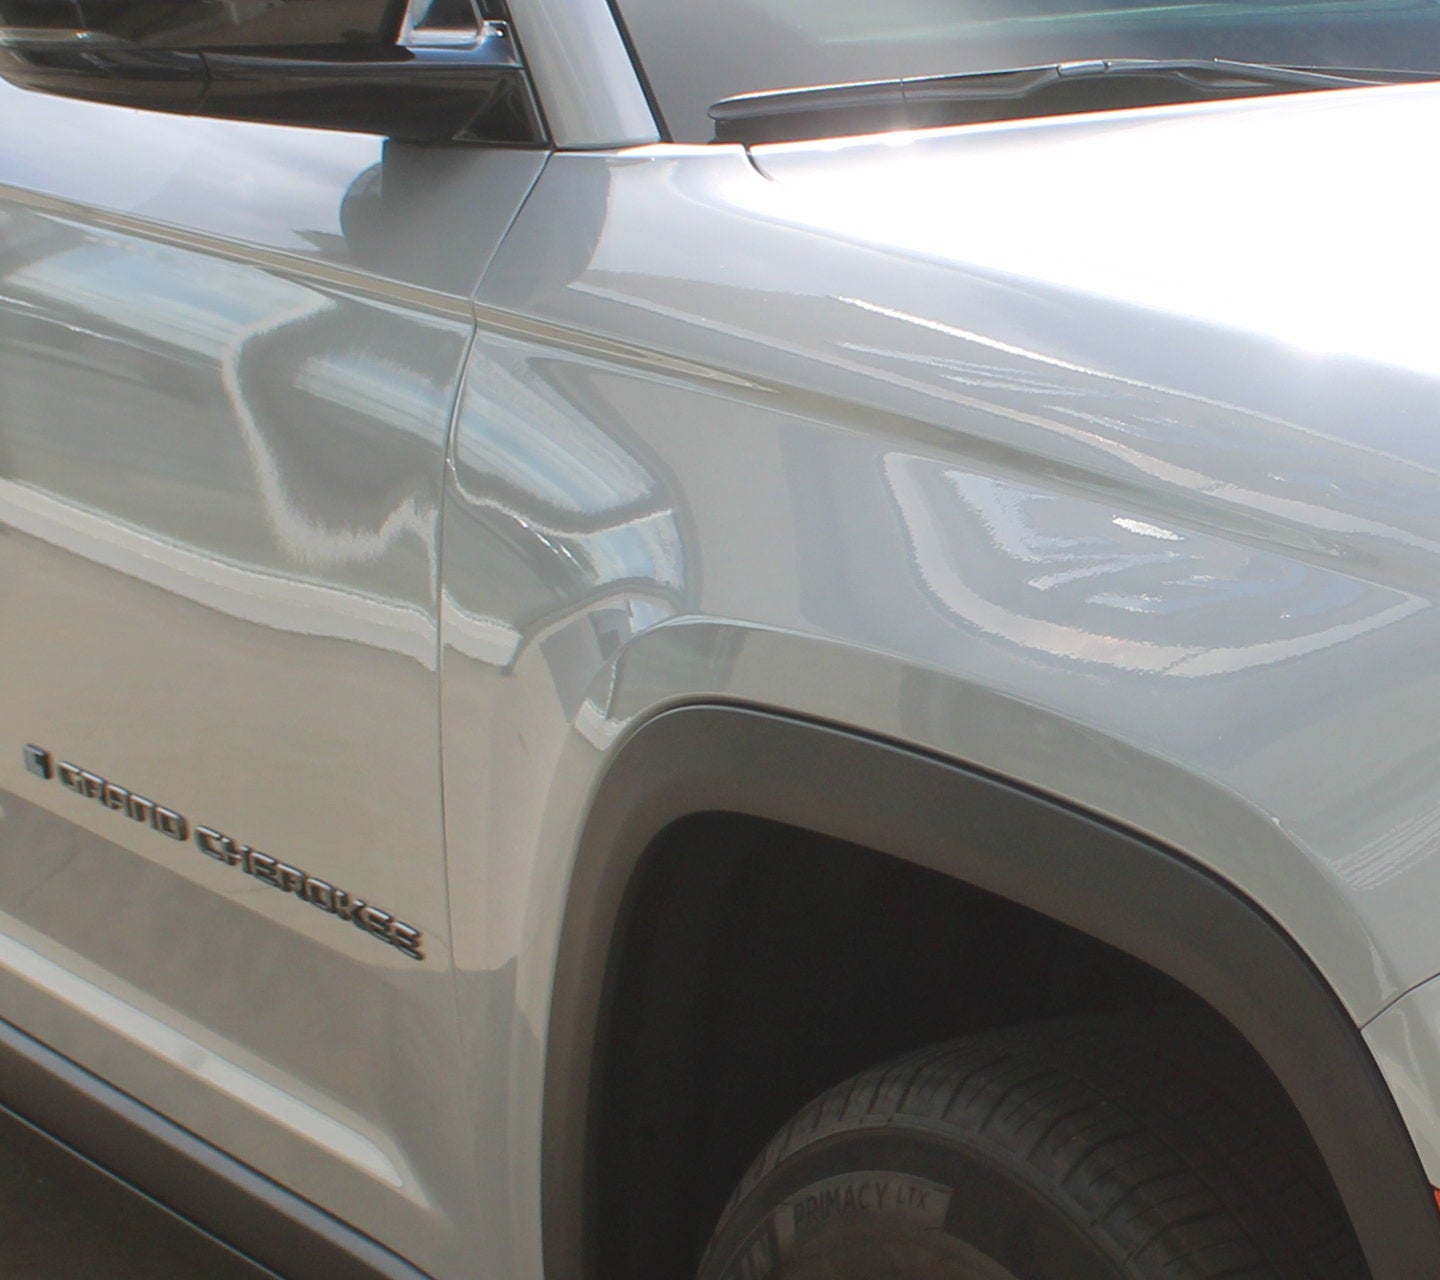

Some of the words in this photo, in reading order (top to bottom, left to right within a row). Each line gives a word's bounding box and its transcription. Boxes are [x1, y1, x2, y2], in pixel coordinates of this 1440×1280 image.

[57, 759, 189, 842] GRAND
[194, 824, 424, 960] CHEROKEE
[794, 1181, 889, 1225] PRIMACY
[897, 1183, 928, 1211] LTX
